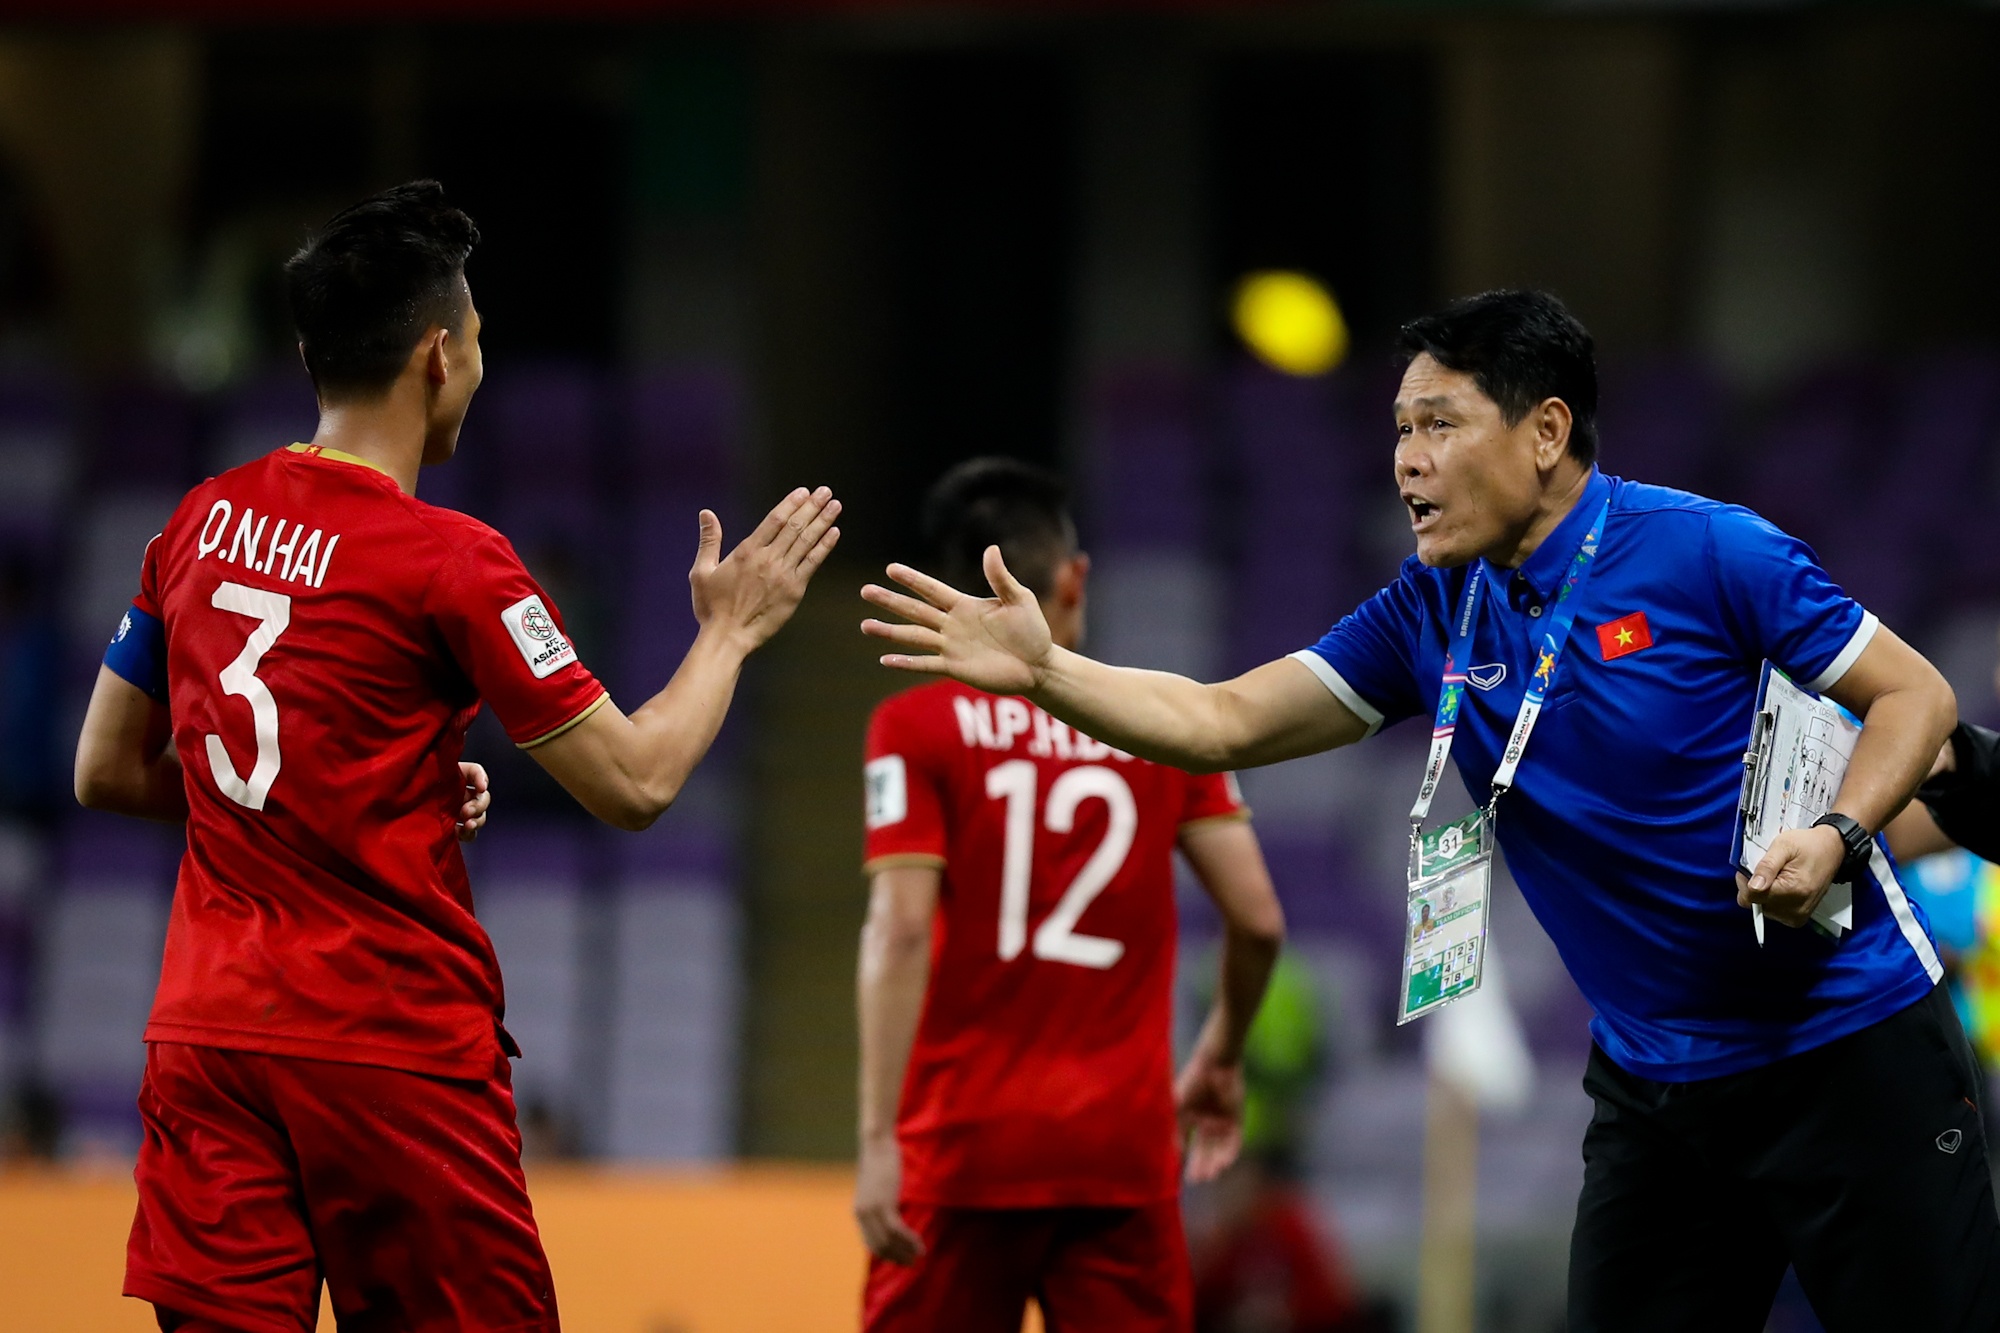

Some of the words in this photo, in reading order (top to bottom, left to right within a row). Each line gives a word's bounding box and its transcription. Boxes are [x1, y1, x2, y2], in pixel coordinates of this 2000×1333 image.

[197, 499, 341, 589] Q.N.HAI
[1460, 596, 1474, 637] BRINGING
[1469, 575, 1479, 595] ASIA
[545, 637, 559, 649] AFC
[533, 645, 560, 666] ASIAN
[545, 655, 559, 666] UAE
[205, 580, 292, 812] 3
[1523, 707, 1532, 723] CUP
[1442, 834, 1458, 854] 31
[985, 759, 1139, 970] 12
[1436, 914, 1453, 926] TEAM
[1452, 903, 1480, 919] OFFICIAL
[1447, 951, 1451, 960] 1
[1457, 946, 1464, 956] 2
[1468, 941, 1475, 951] 3
[1445, 964, 1451, 973] 4
[1444, 977, 1450, 987] 7
[1454, 972, 1461, 982] 8
